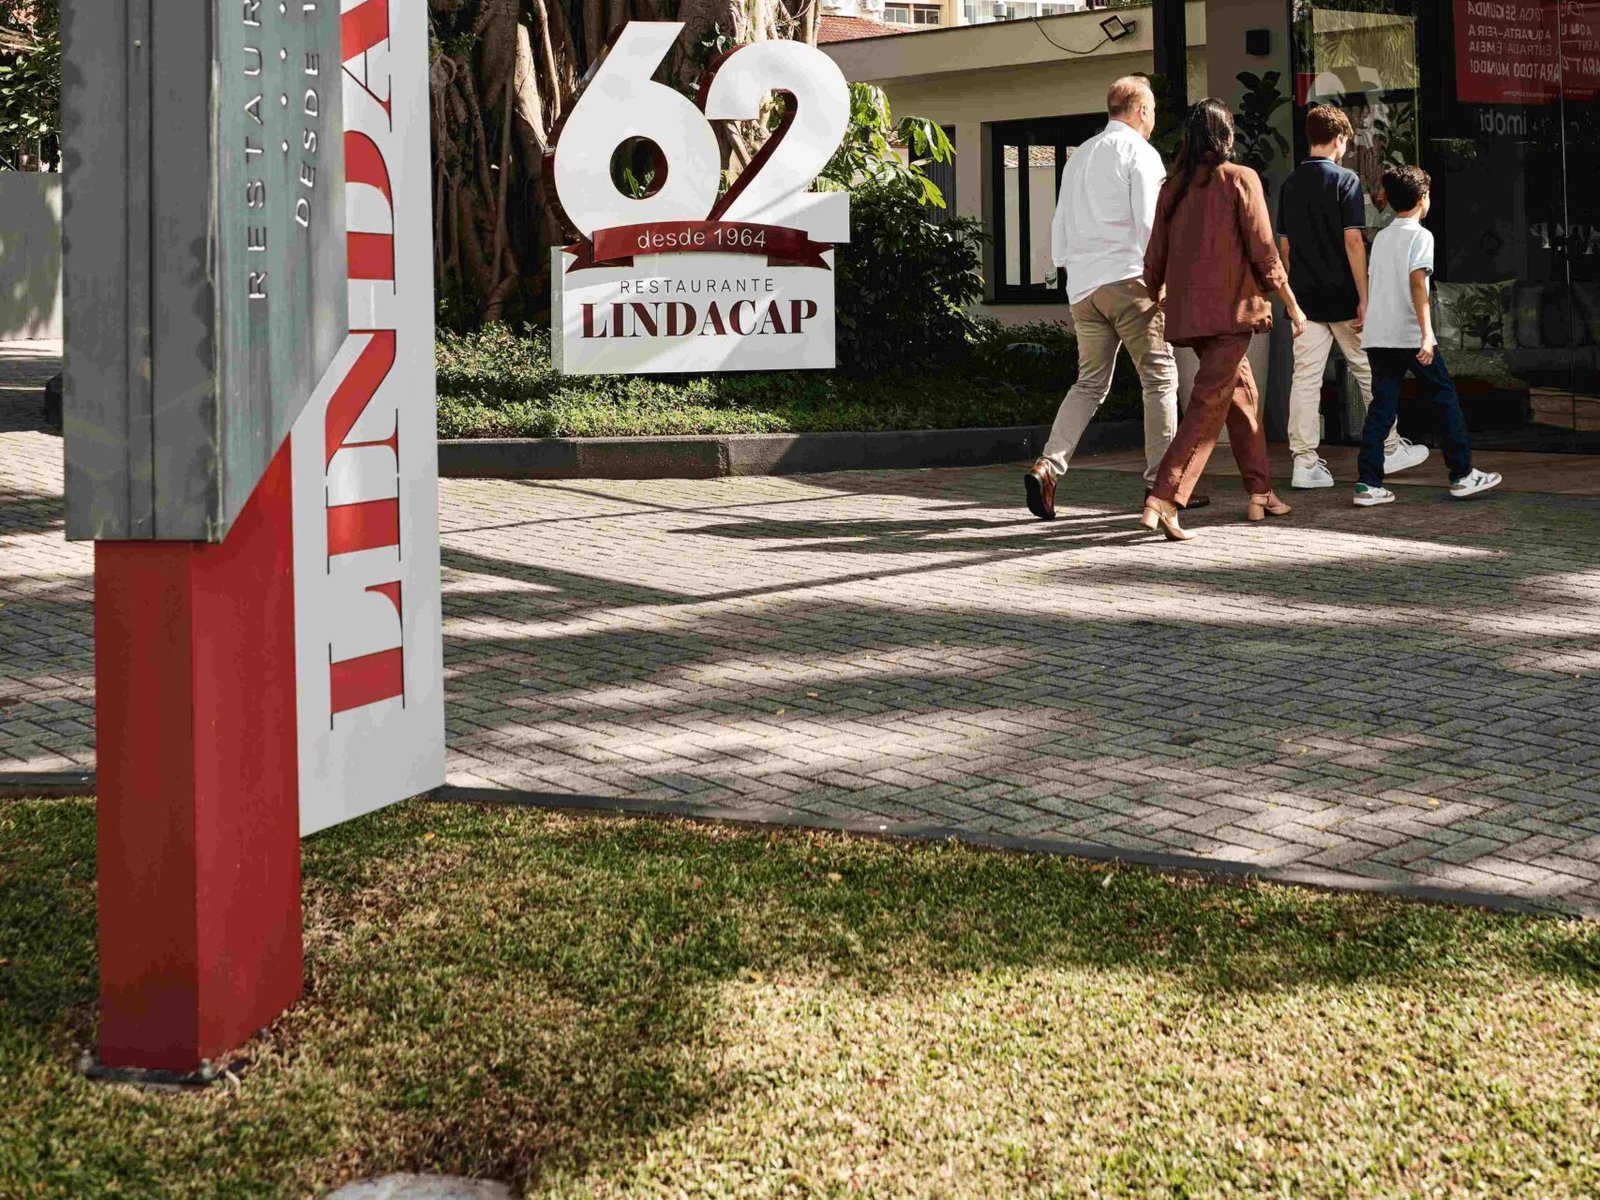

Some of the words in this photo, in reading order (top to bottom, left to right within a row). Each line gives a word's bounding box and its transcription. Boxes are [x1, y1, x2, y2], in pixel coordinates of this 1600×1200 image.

[295, 51, 320, 228] DESDE
[554, 21, 850, 243] 62
[637, 228, 705, 249] desde
[714, 228, 766, 248] 1964
[620, 278, 774, 294] RESTAURANTE
[580, 299, 818, 338] LINDACAP
